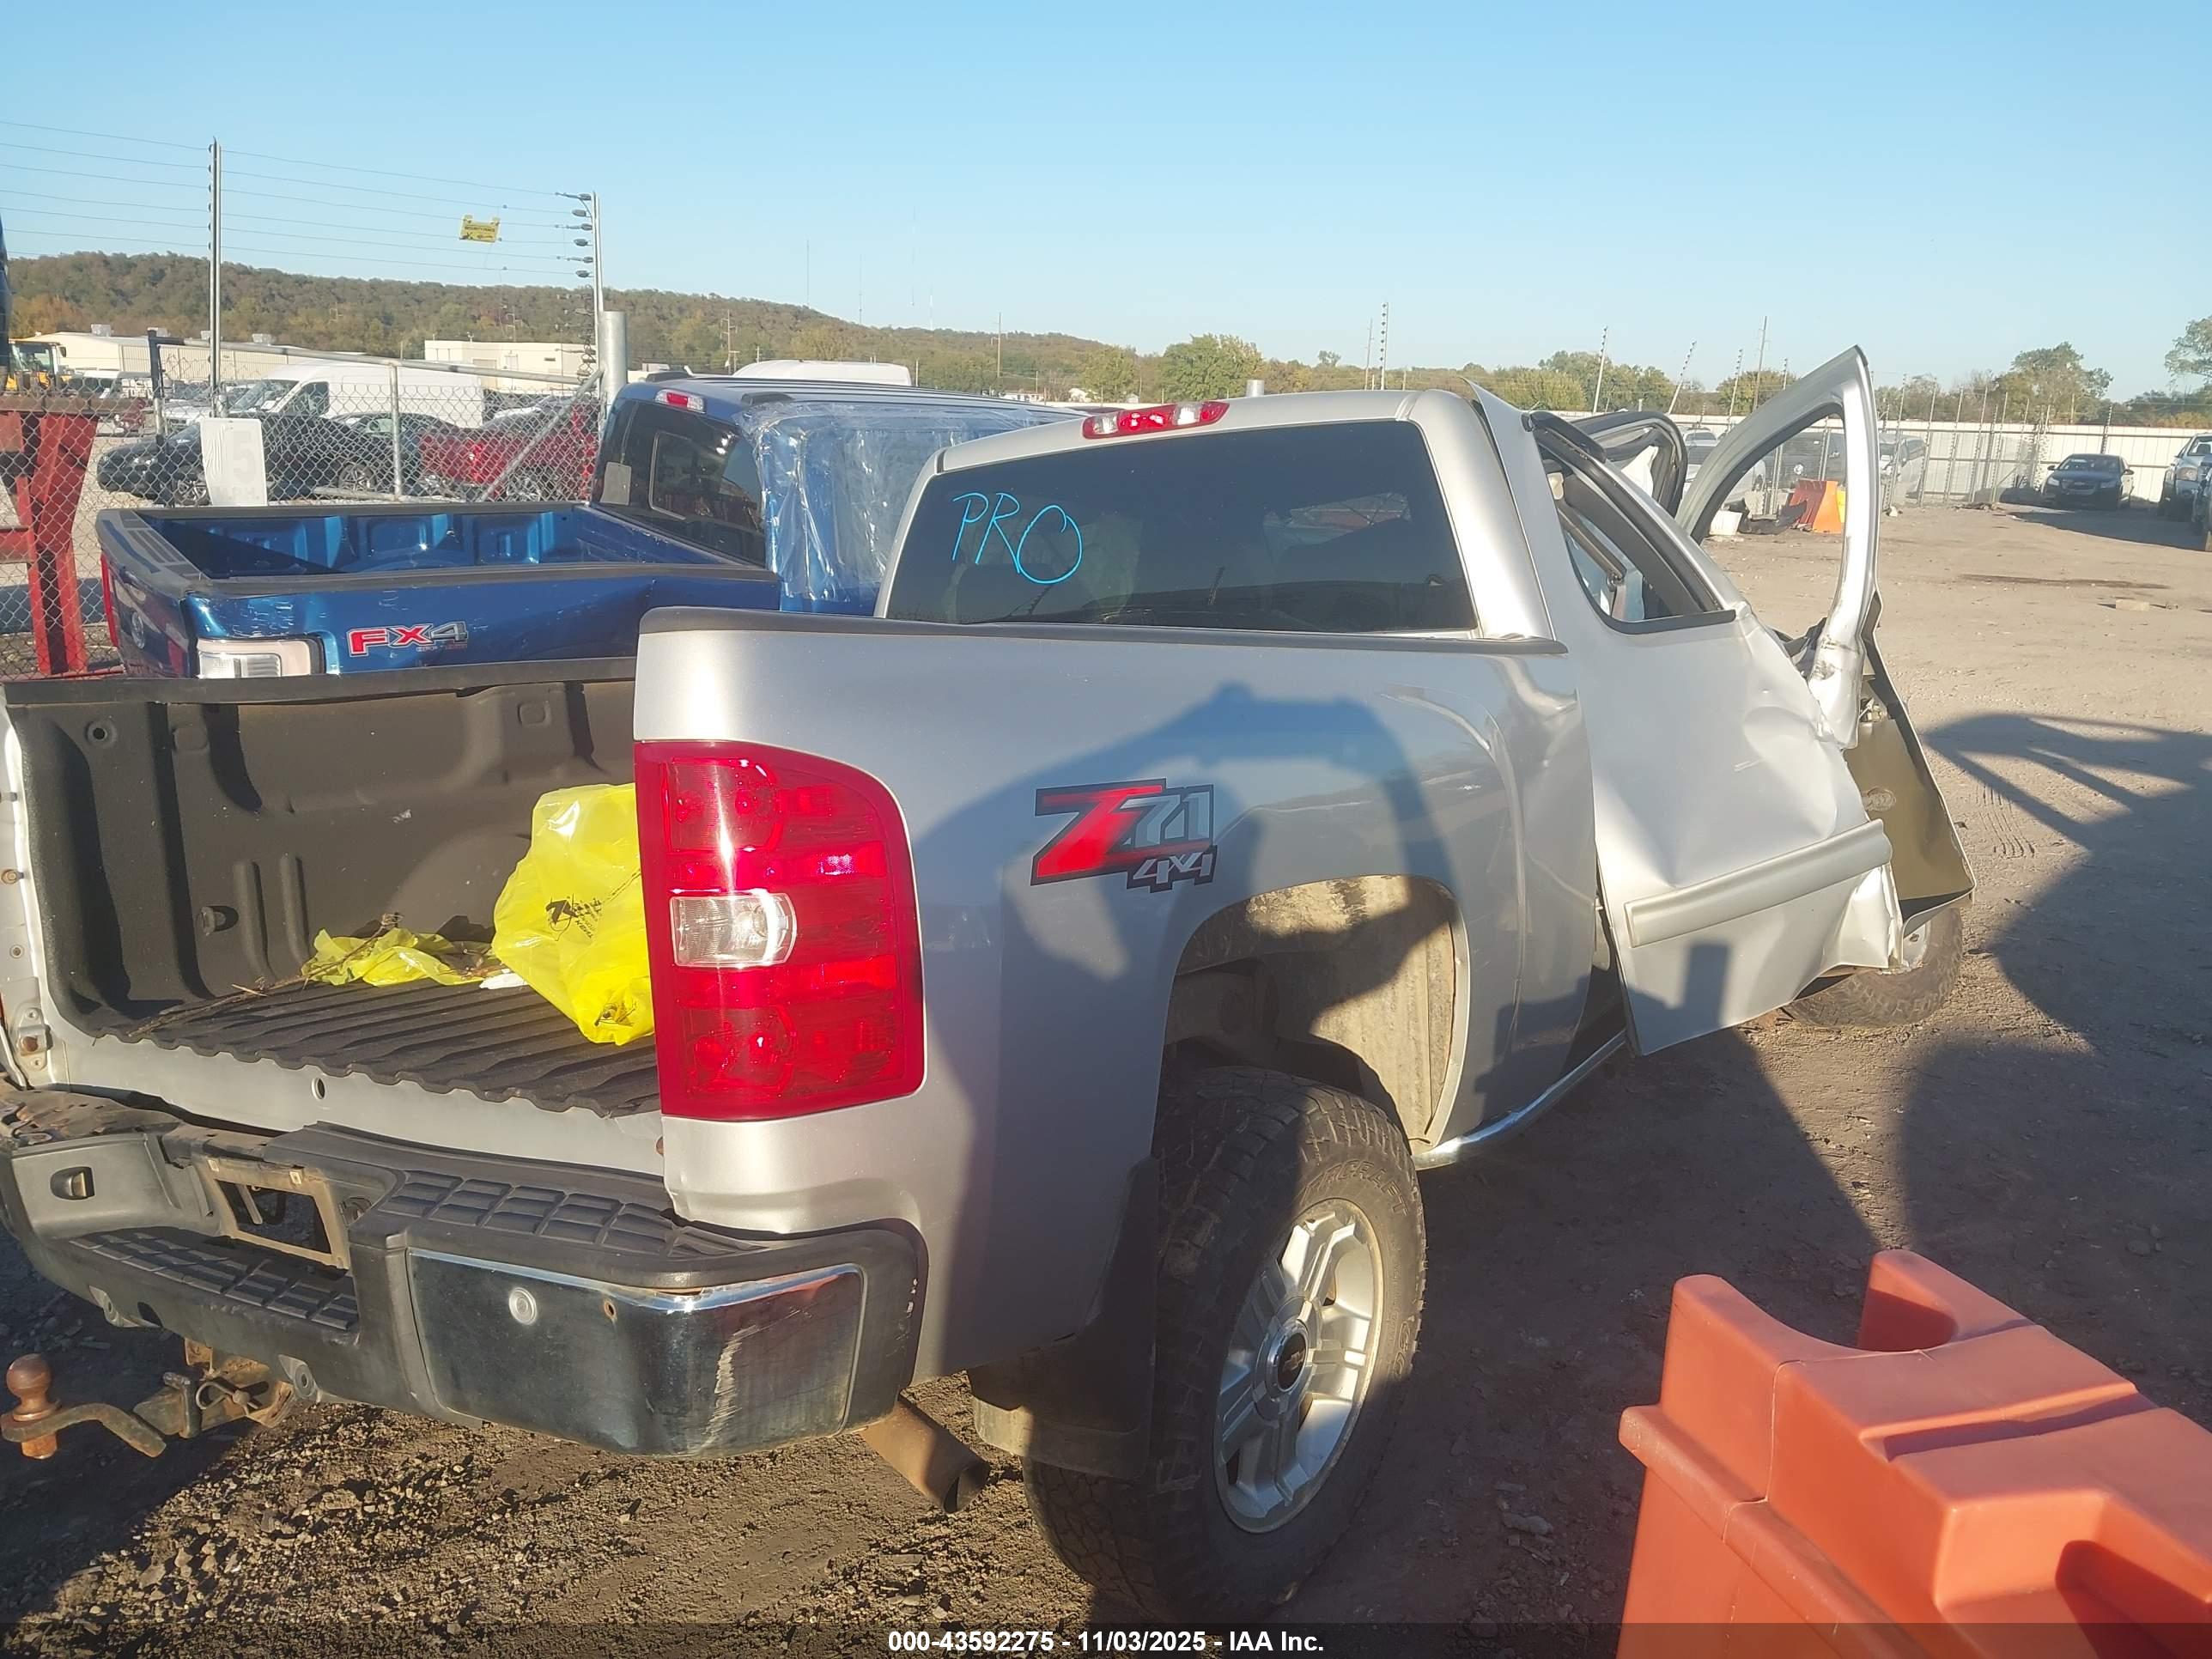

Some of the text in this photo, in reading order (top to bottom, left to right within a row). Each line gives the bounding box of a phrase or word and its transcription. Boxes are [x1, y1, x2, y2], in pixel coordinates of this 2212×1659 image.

[952, 492, 1083, 585] PRO
[347, 621, 469, 657] FX4
[1031, 778, 1214, 886] Z71
